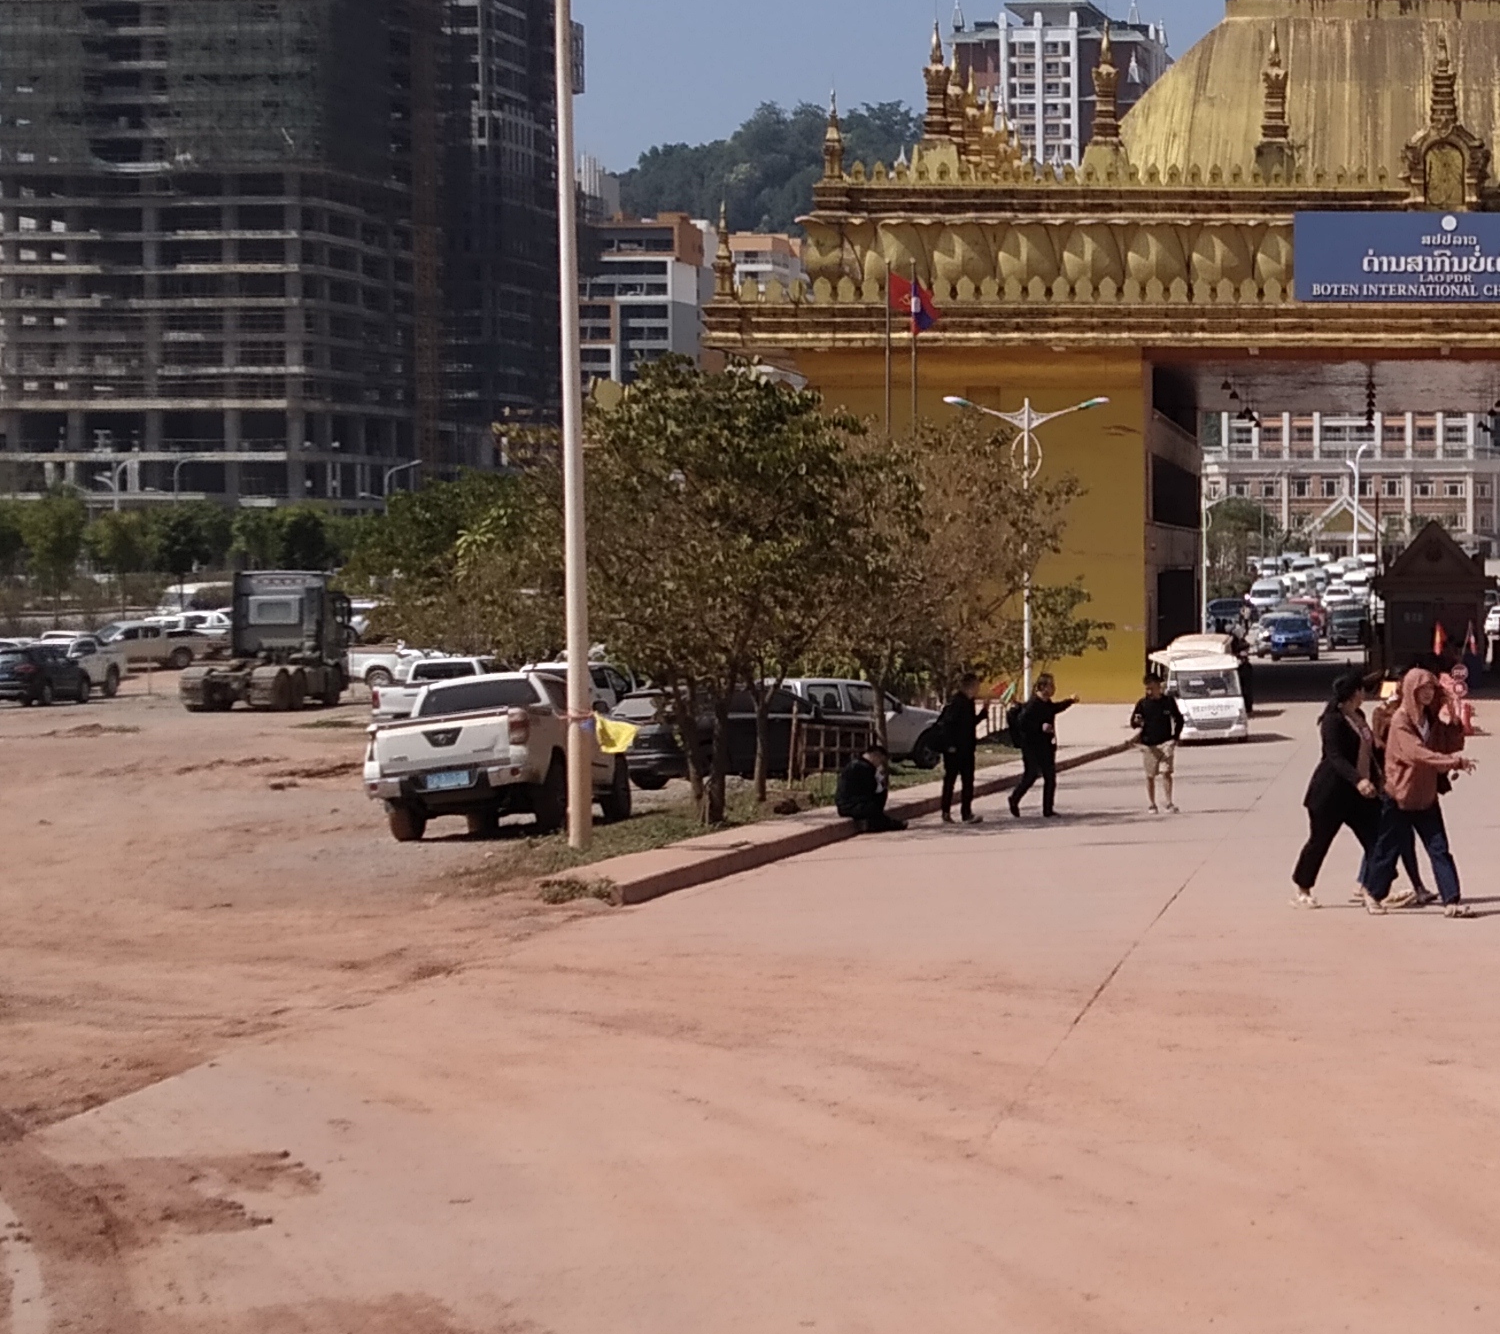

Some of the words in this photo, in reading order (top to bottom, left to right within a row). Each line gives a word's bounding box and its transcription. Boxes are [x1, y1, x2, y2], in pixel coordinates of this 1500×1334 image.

[1419, 273, 1445, 283] LAO
[1446, 273, 1473, 283] PDR
[1312, 283, 1359, 297] BOTEN
[1362, 283, 1479, 297] INTERNATIONAL
